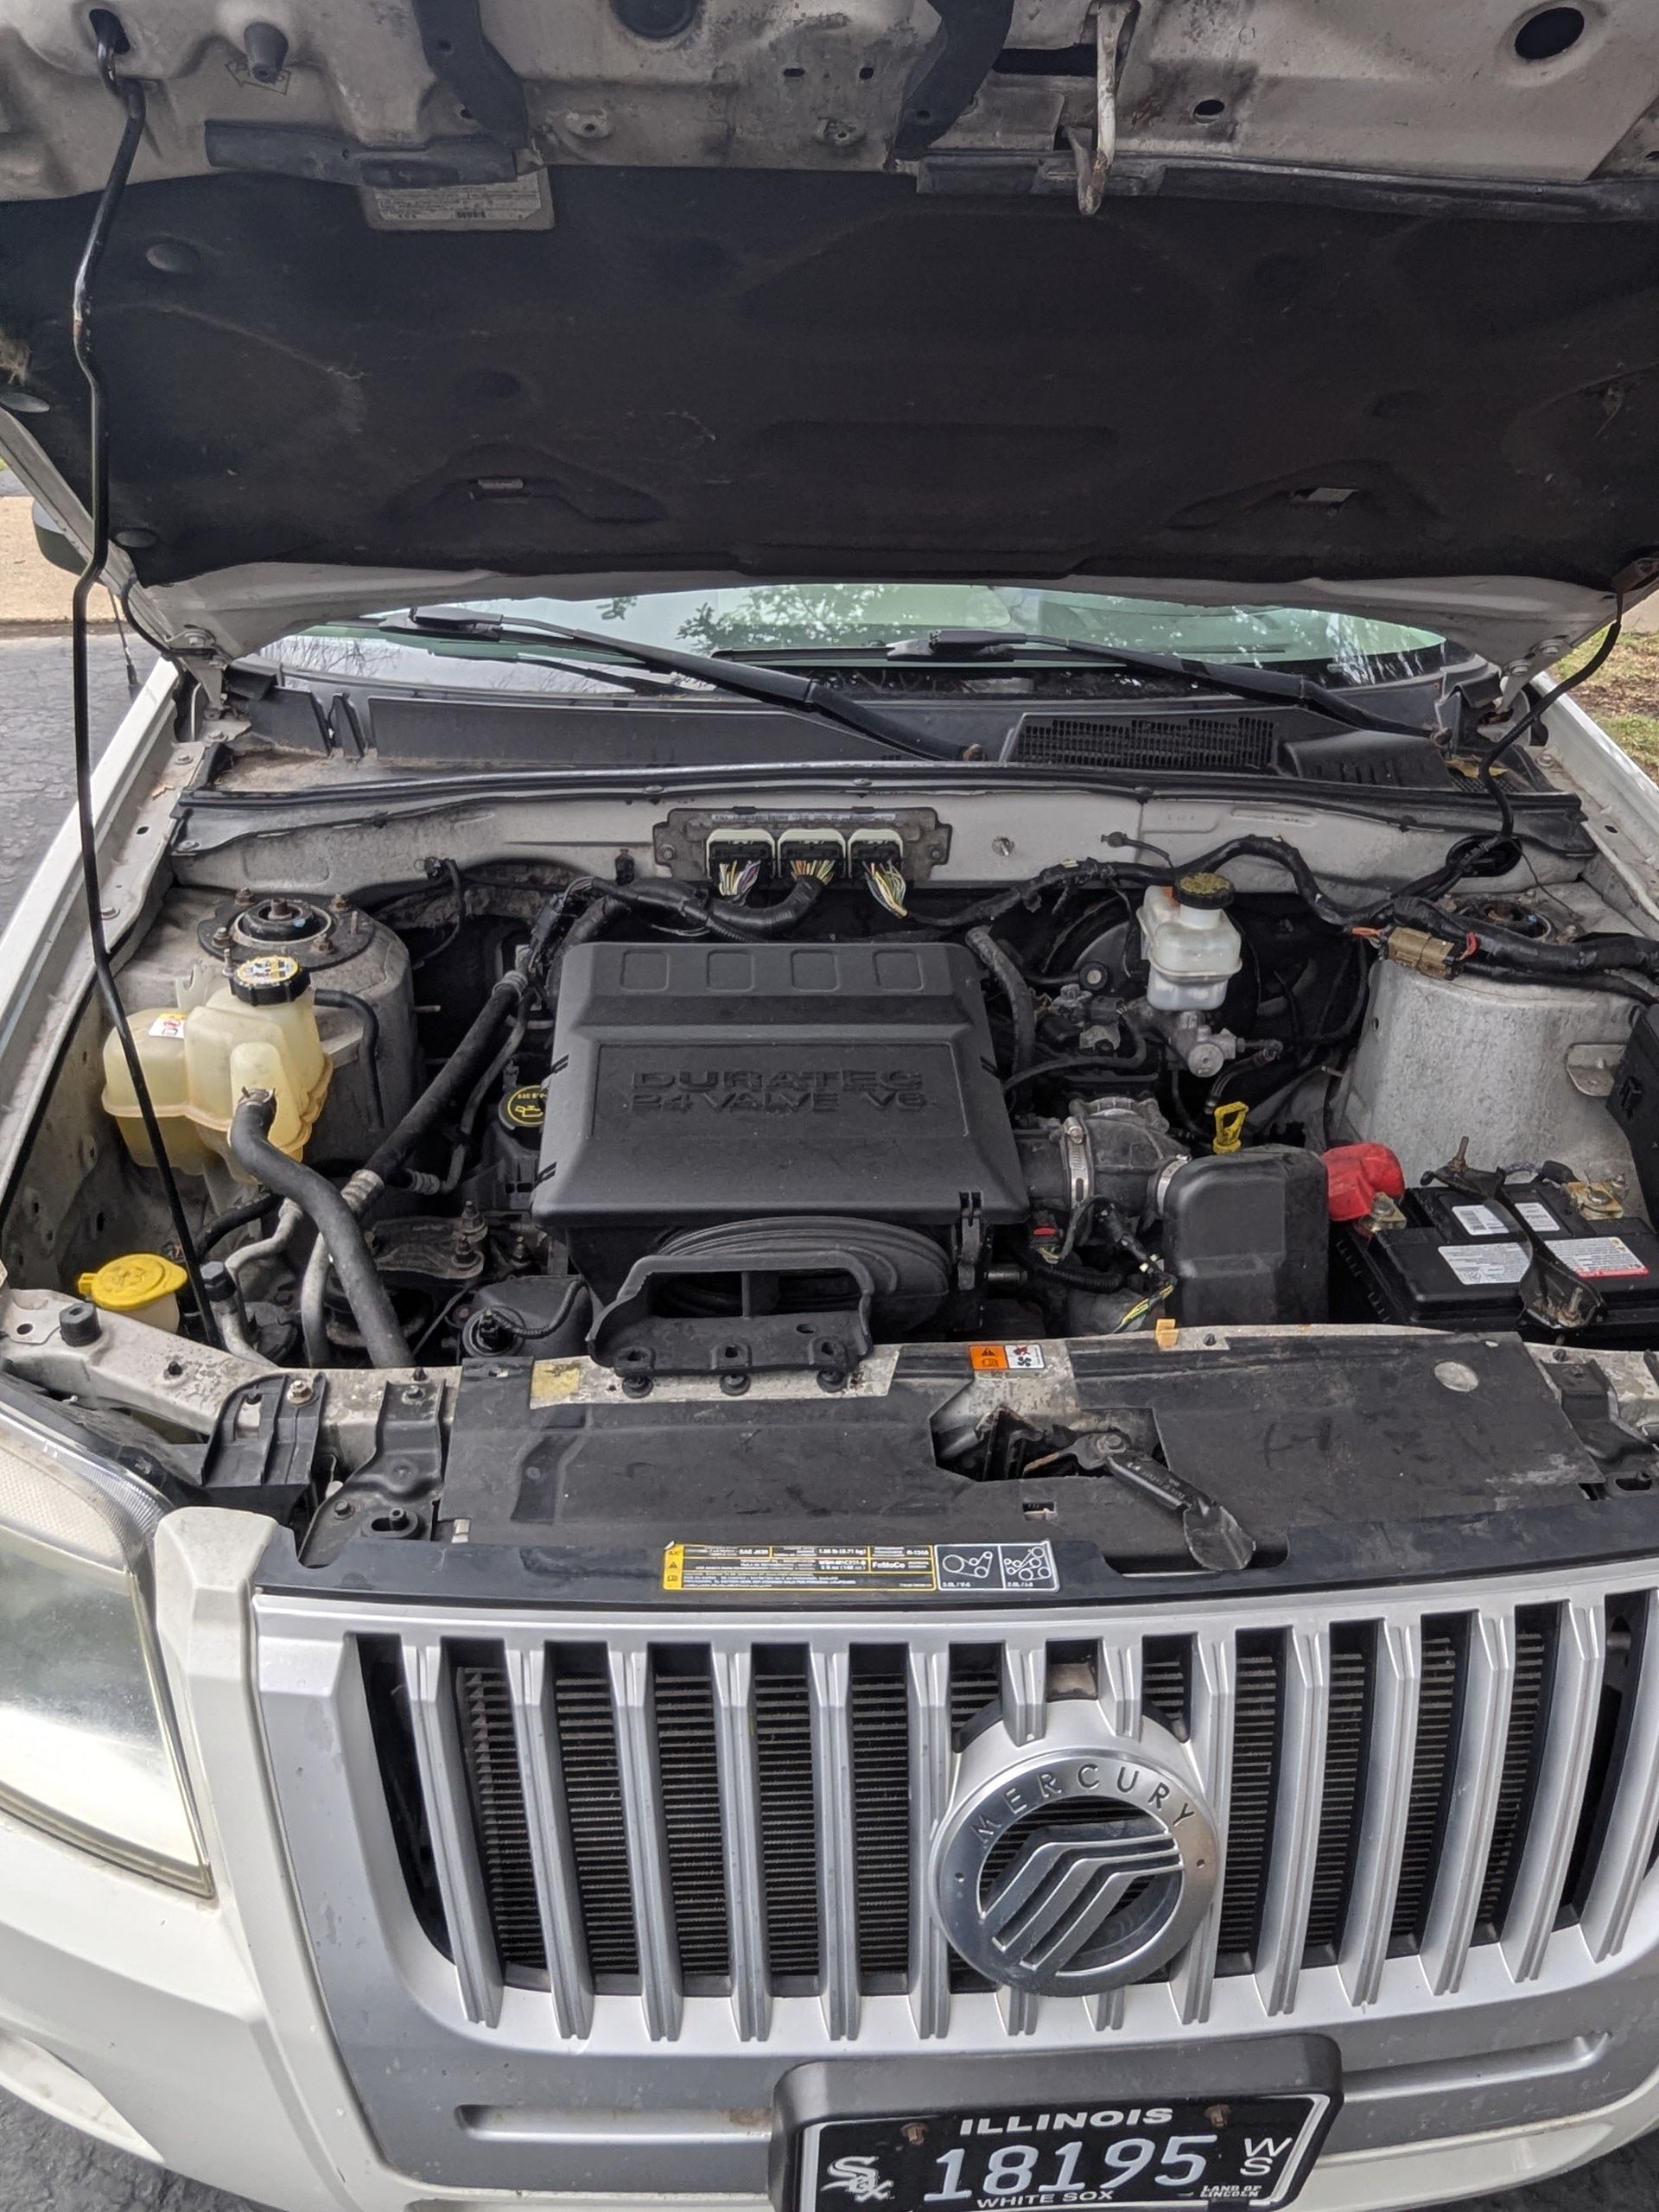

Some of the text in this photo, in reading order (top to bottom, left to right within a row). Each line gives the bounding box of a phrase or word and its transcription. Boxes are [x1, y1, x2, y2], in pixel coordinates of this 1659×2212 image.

[631, 1071, 923, 1091] DURATEC
[864, 1091, 927, 1113] V6
[969, 1764, 1195, 1844] MERCURY
[959, 2108, 1173, 2136] ILLINOIS
[1244, 2137, 1293, 2158] W
[924, 2134, 1217, 2202] 18195
[1240, 2158, 1274, 2177] S
[976, 2190, 1114, 2208] WHITE SOX
